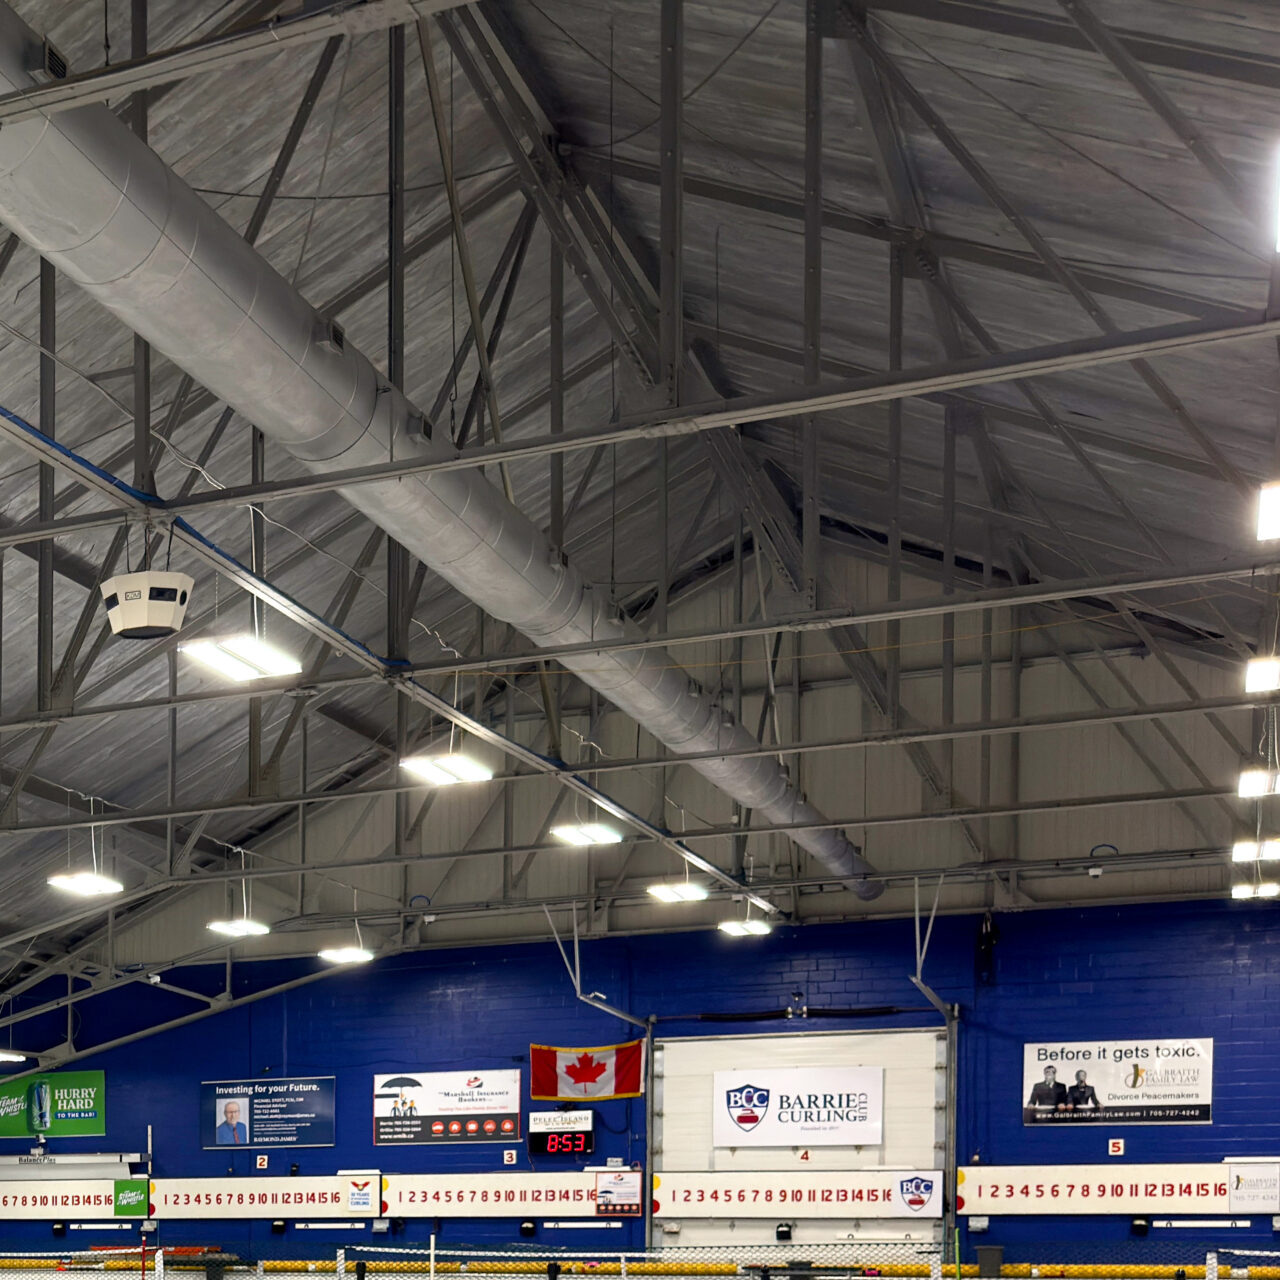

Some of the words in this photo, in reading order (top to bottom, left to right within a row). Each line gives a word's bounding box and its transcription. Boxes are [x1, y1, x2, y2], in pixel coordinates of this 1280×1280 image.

[1037, 1048, 1092, 1062] Before
[1098, 1047, 1107, 1060] it
[1113, 1046, 1149, 1062] gets
[1156, 1045, 1200, 1058] toxic.
[55, 1088, 97, 1100] HURRY
[216, 1085, 253, 1095] Investing
[255, 1084, 267, 1093] for
[268, 1085, 288, 1095] your
[289, 1083, 320, 1092] Future.
[730, 1088, 768, 1108] BCC
[779, 1093, 858, 1109] BARRIE
[1108, 1093, 1140, 1101] Divorce
[1142, 1092, 1200, 1100] Peacemakers
[57, 1099, 94, 1110] HARD
[858, 1093, 868, 1122] CLUB
[778, 1109, 858, 1123] CURLING
[547, 1133, 586, 1152] 8:53
[1111, 1142, 1121, 1153] 5
[259, 1157, 266, 1167] 2
[506, 1152, 514, 1163] 3
[800, 1150, 809, 1161] 4
[903, 1179, 932, 1194] BCC
[990, 1184, 1000, 1198] 2
[1005, 1184, 1014, 1198] 3
[1020, 1184, 1030, 1198] 4
[1035, 1184, 1044, 1198] 5
[1051, 1184, 1060, 1198] 6
[1067, 1184, 1075, 1198] 7
[1081, 1184, 1090, 1198] 8
[1097, 1184, 1106, 1197] 9
[1111, 1184, 1124, 1197] 10
[1130, 1184, 1139, 1197] 11
[1145, 1183, 1157, 1197] 12
[1162, 1183, 1175, 1197] 13
[1179, 1183, 1192, 1197] 14
[1196, 1183, 1210, 1197] 15
[1214, 1183, 1227, 1197] 16
[2, 1196, 8, 1206] 6
[12, 1195, 18, 1206] 7
[21, 1195, 28, 1206] 8
[31, 1195, 37, 1206] 9
[40, 1195, 48, 1206] 10
[52, 1195, 58, 1206] 11
[61, 1195, 69, 1206] 12
[72, 1195, 80, 1206] 13
[82, 1195, 92, 1206] 14
[93, 1195, 102, 1206] 15
[104, 1194, 113, 1206] 16
[173, 1194, 180, 1206] 2
[183, 1194, 191, 1206] 3
[194, 1194, 202, 1206] 4
[205, 1193, 212, 1205] 5
[215, 1193, 222, 1205] 6
[226, 1193, 233, 1205] 7
[237, 1193, 244, 1205] 8
[248, 1193, 255, 1205] 9
[258, 1193, 268, 1205] 10
[272, 1193, 278, 1205] 11
[282, 1193, 292, 1205] 12
[293, 1192, 304, 1204] 13
[306, 1192, 316, 1204] 14
[319, 1192, 328, 1204] 15
[331, 1192, 341, 1204] 16
[408, 1191, 416, 1203] 2
[421, 1191, 428, 1203] 3
[432, 1191, 440, 1203] 4
[445, 1191, 452, 1202] 5
[457, 1191, 464, 1202] 6
[470, 1191, 477, 1202] 7
[481, 1191, 489, 1202] 8
[494, 1191, 501, 1202] 9
[505, 1191, 515, 1202] 10
[520, 1190, 527, 1202] 11
[531, 1190, 542, 1202] 12
[545, 1190, 555, 1201] 13
[559, 1190, 570, 1201] 14
[573, 1190, 584, 1201] 15
[683, 1190, 692, 1202] 2
[697, 1190, 706, 1202] 3
[710, 1190, 719, 1202] 4
[724, 1190, 732, 1202] 5
[737, 1190, 746, 1202] 6
[752, 1190, 760, 1202] 7
[765, 1190, 773, 1202] 8
[779, 1189, 787, 1202] 9
[791, 1189, 803, 1202] 10
[808, 1189, 816, 1202] 11
[821, 1189, 833, 1202] 12
[836, 1189, 848, 1202] 13
[852, 1189, 864, 1202] 14
[867, 1189, 879, 1202] 15
